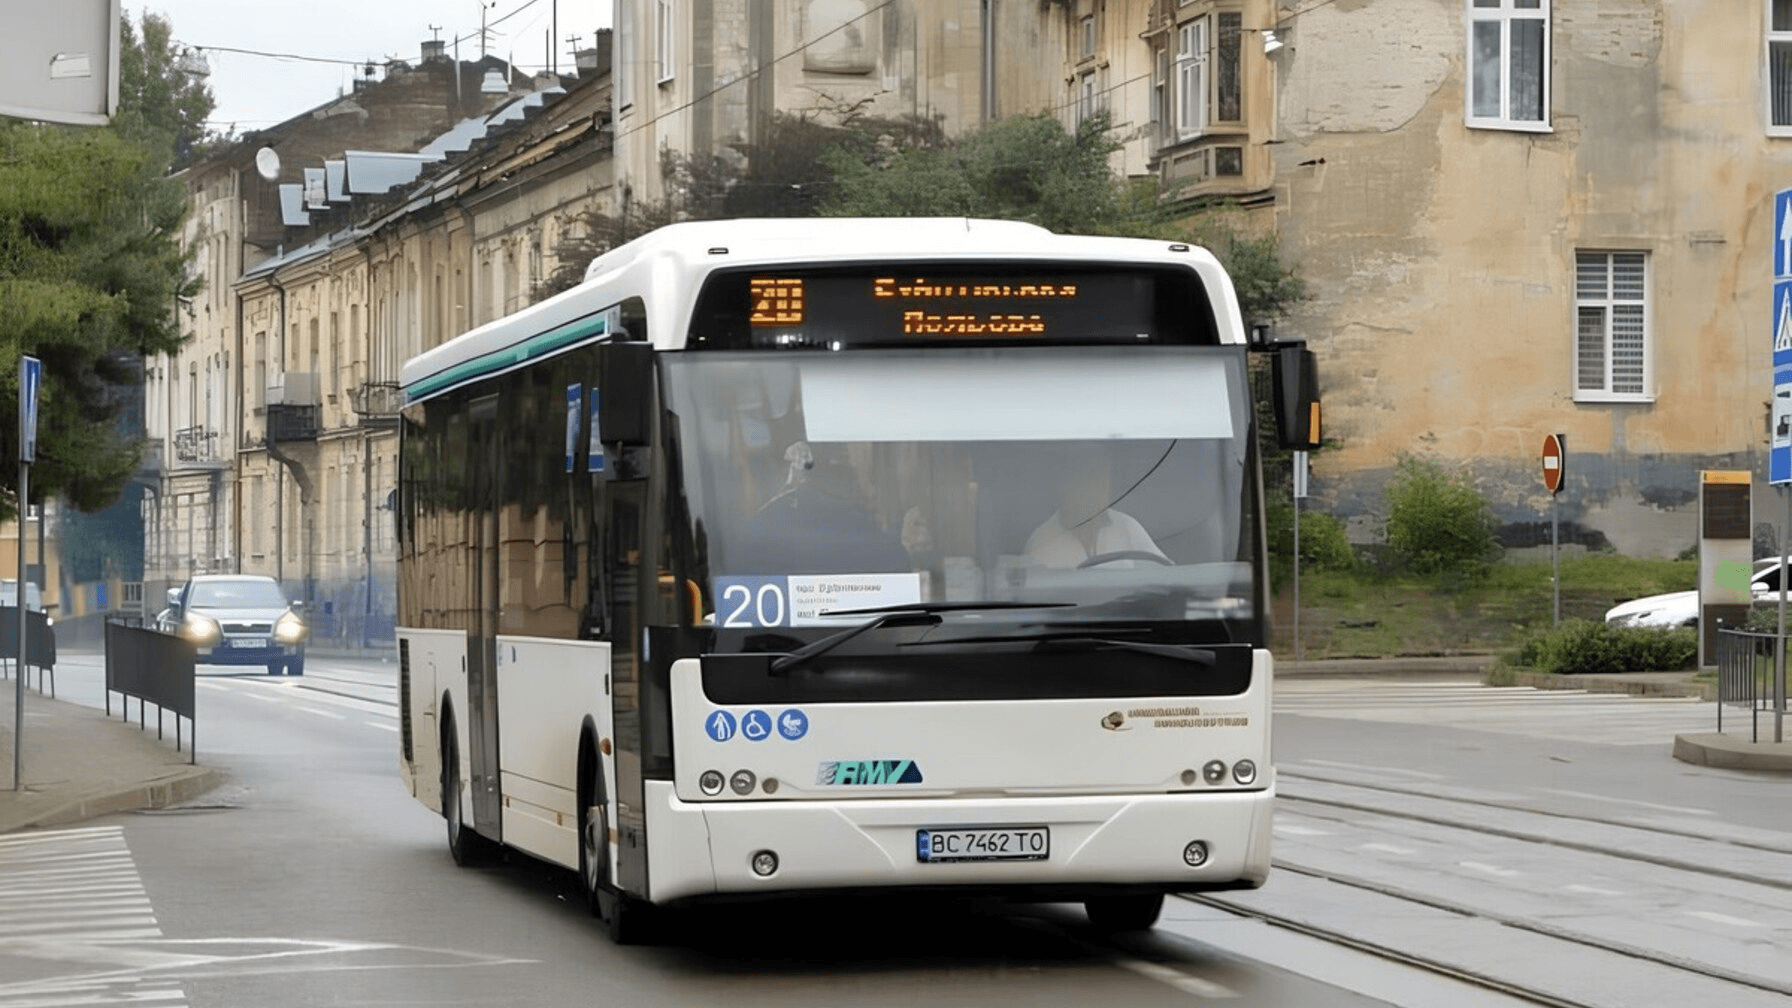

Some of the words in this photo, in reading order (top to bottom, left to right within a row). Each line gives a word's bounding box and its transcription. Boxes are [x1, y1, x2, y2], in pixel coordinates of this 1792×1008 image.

[723, 583, 785, 628] 20
[931, 834, 960, 853] BC
[965, 833, 1010, 852] 7462
